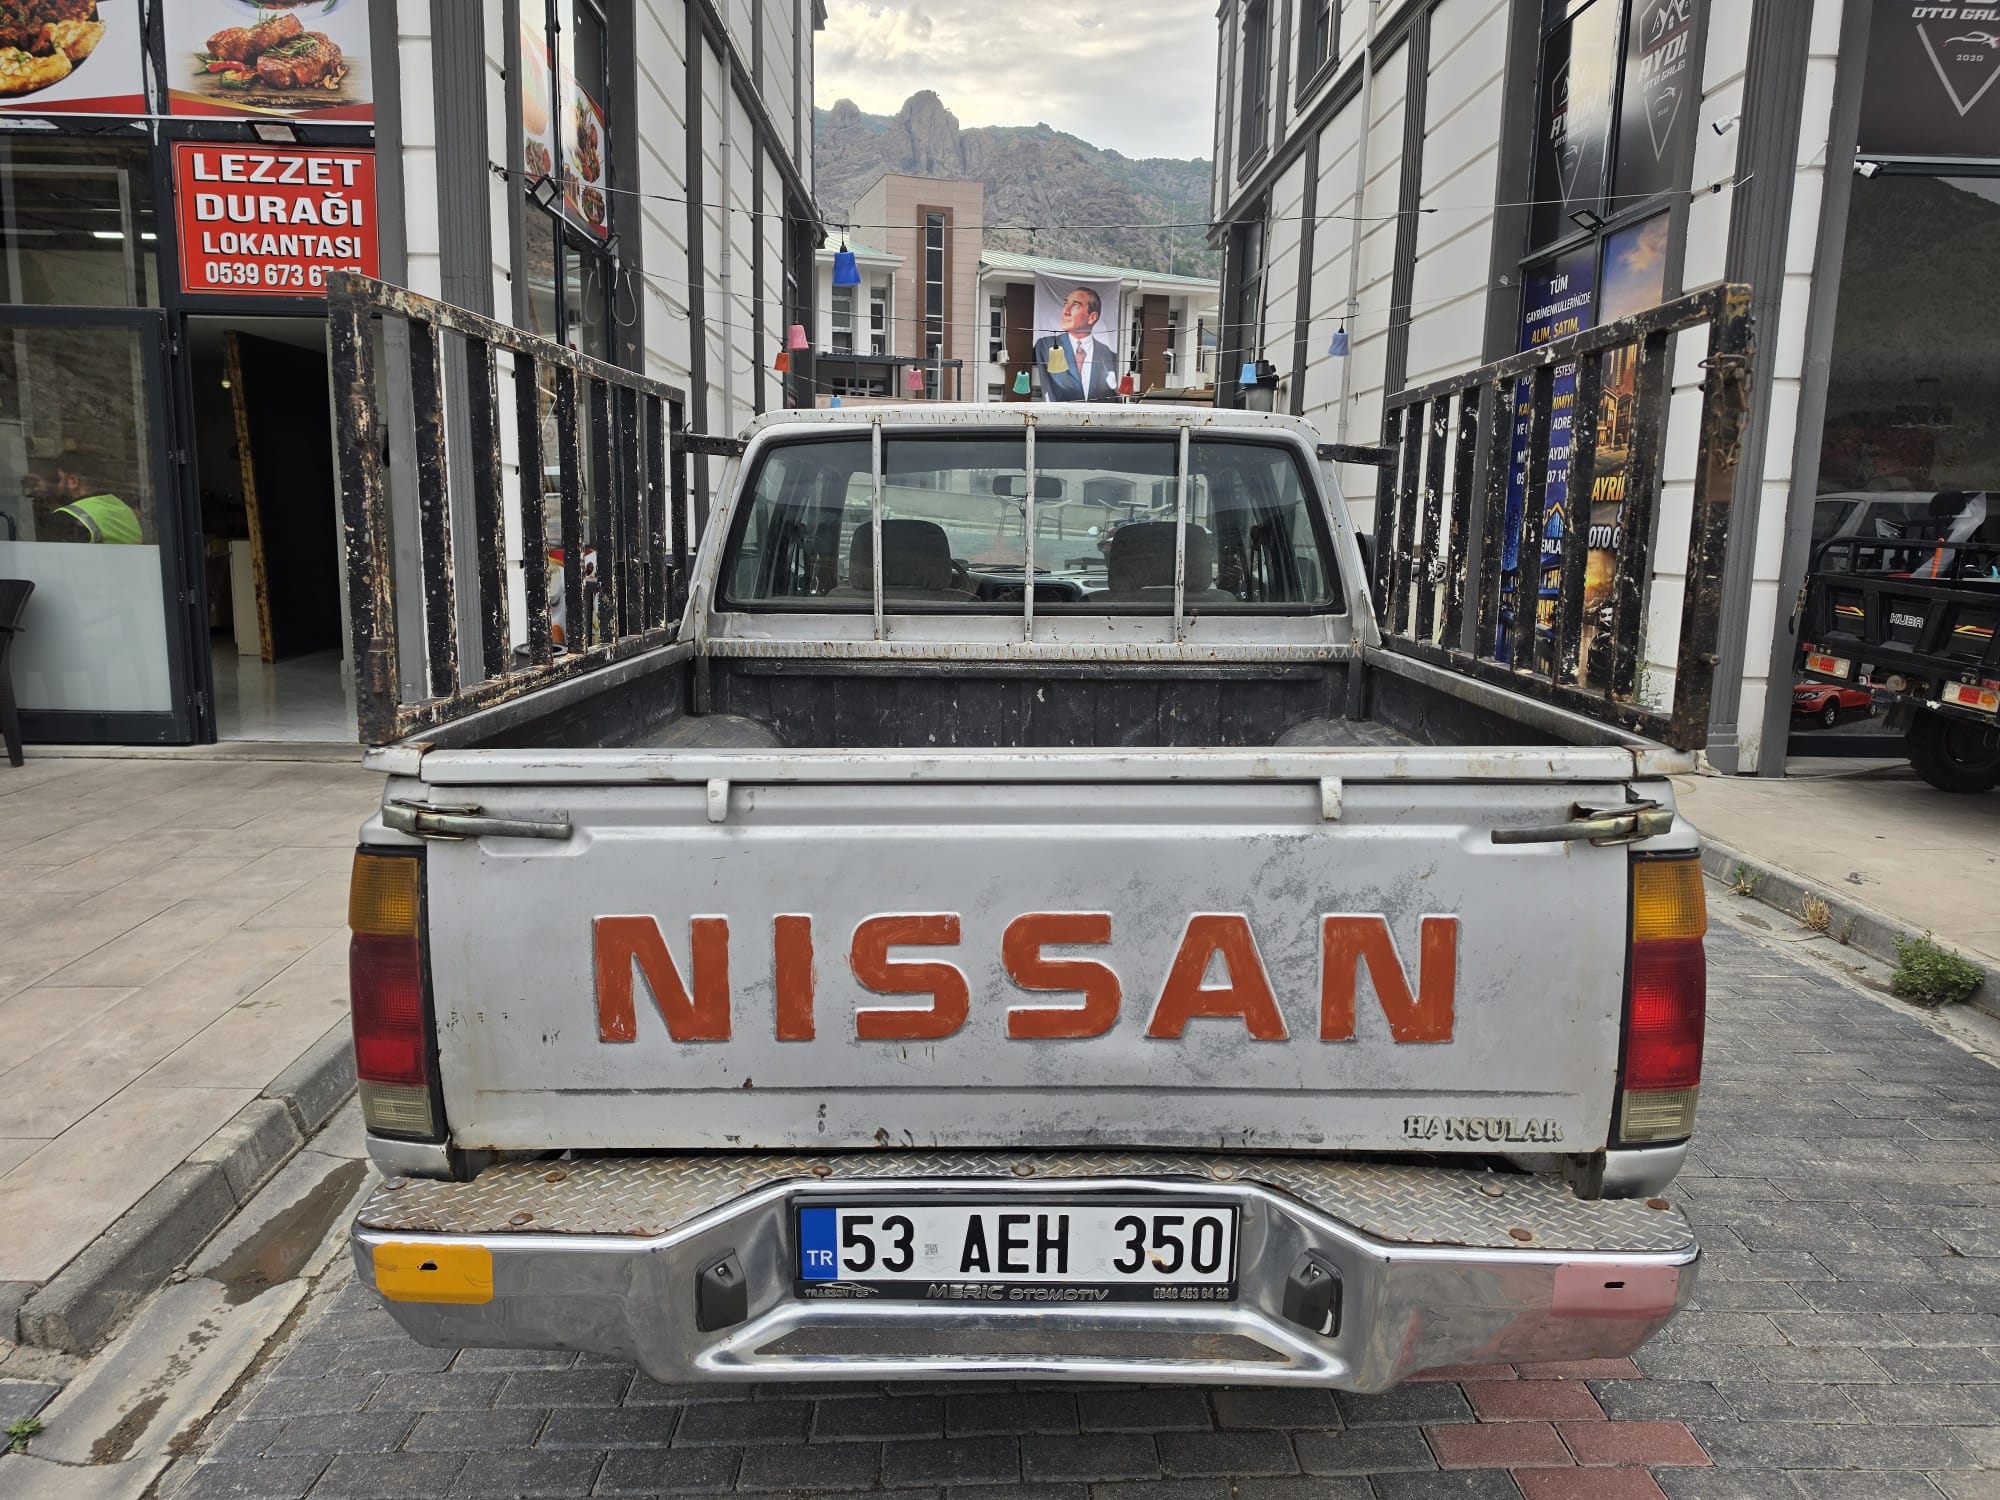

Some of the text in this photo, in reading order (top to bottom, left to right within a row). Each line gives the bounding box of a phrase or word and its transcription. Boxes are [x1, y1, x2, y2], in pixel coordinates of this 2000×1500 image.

[1912, 7, 1957, 18] OTO
[1637, 30, 1688, 82] AYDI
[193, 153, 362, 186] LEZZET
[195, 191, 363, 226] DURAĞI
[202, 231, 362, 259] LOKANTASI
[205, 261, 260, 285] 0539
[264, 263, 304, 287] 673
[1550, 274, 1568, 295] TÜM
[1531, 316, 1579, 344] ALIM, SATIM,
[1552, 416, 1571, 430] ADRE
[1541, 539, 1561, 554] EMLA
[1588, 526, 1611, 548] OTO
[1890, 612, 1924, 628] KUBA
[592, 911, 1459, 1046] NISSAN
[1404, 1115, 1564, 1143] HANSULAR
[841, 1214, 1223, 1274] 53 AEH 350
[806, 1250, 834, 1266] TR
[1216, 1287, 1229, 1299] 22
